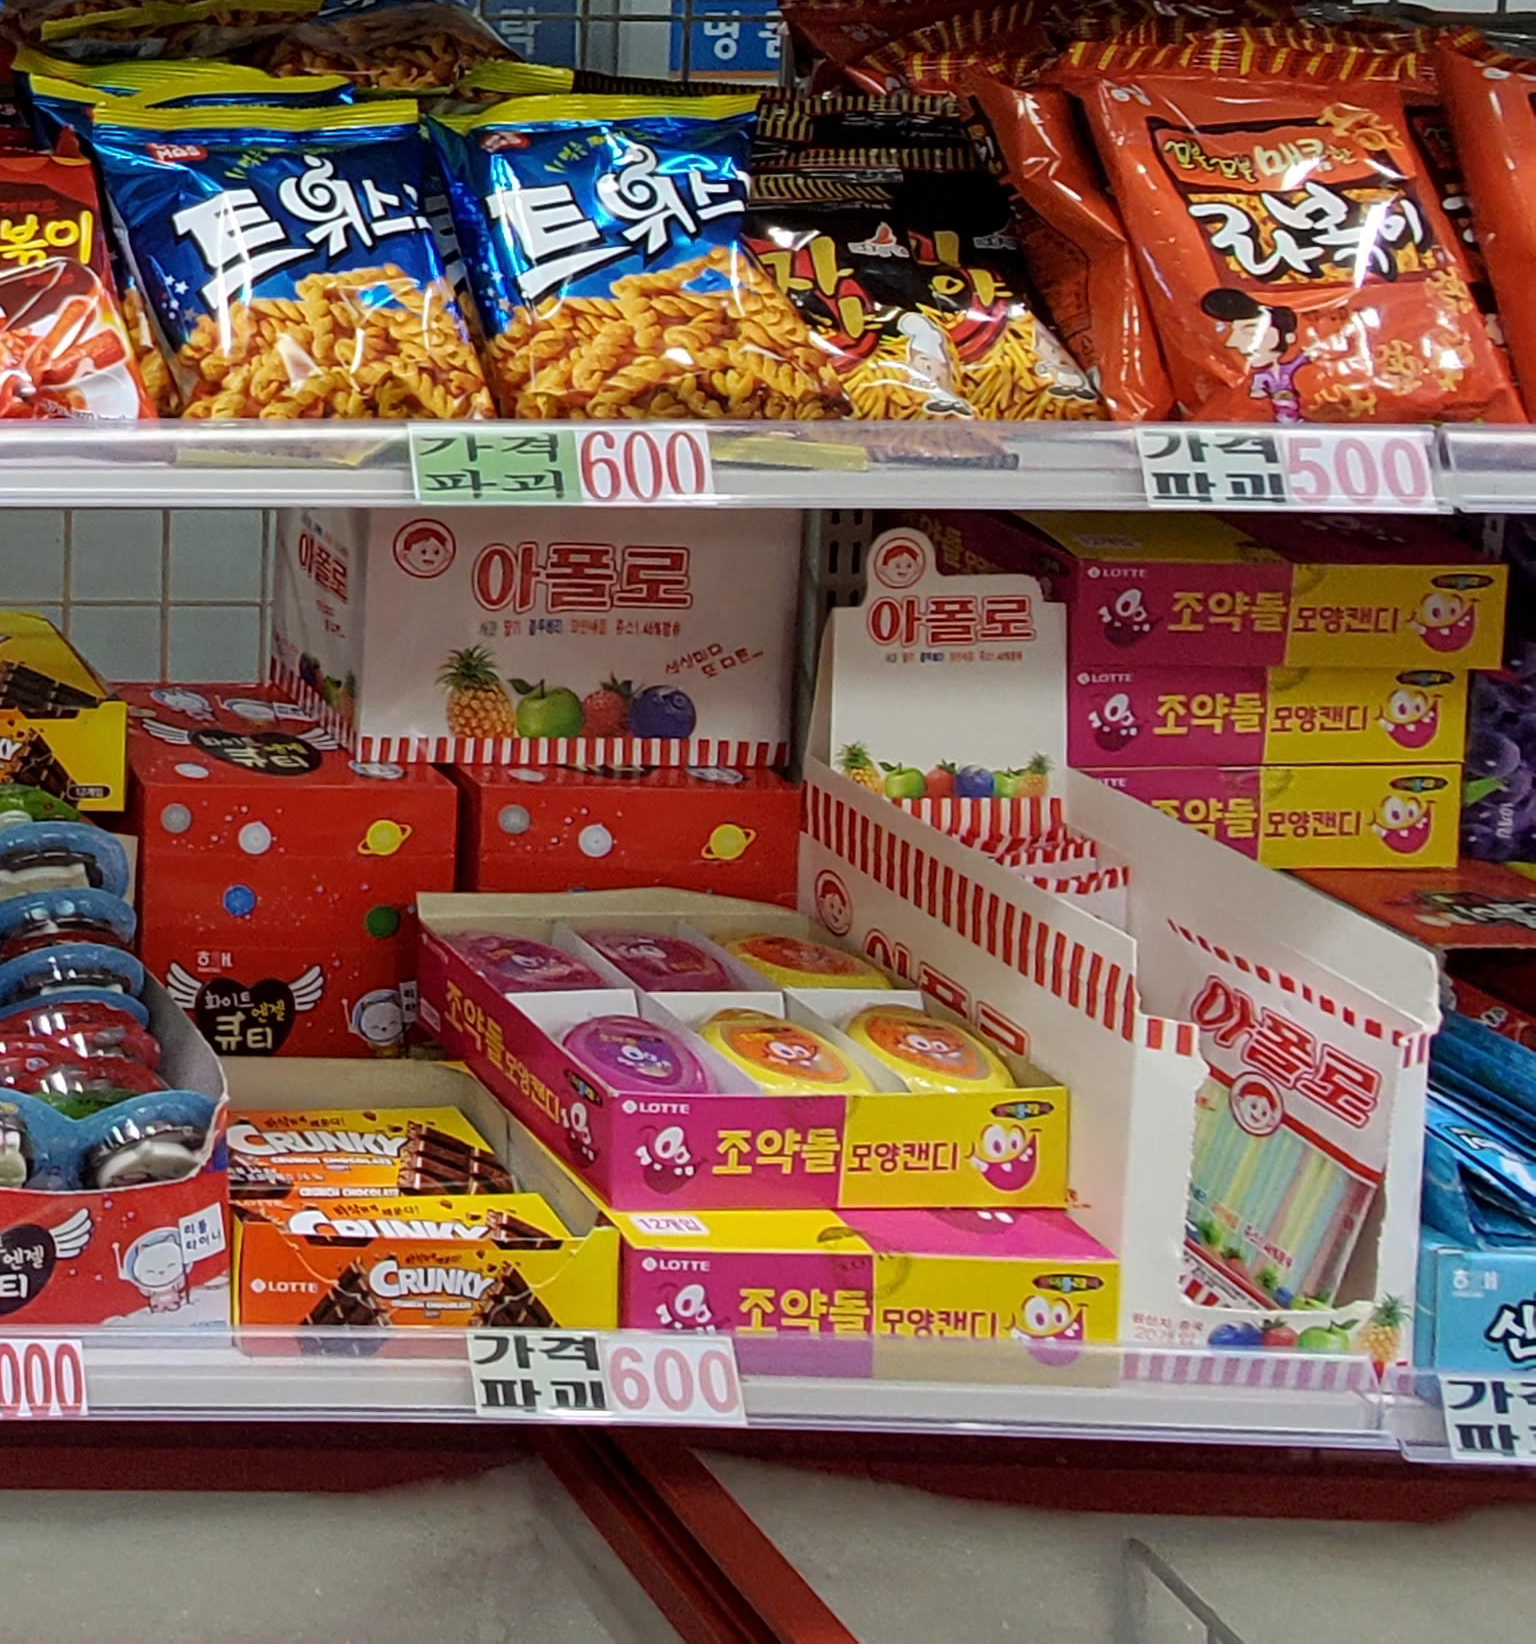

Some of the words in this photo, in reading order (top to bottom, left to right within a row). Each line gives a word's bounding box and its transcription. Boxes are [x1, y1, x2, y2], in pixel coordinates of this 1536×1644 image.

[580, 431, 706, 503] 600
[1287, 439, 1431, 507] 500
[472, 540, 693, 615] 아폴로
[1103, 566, 1148, 579] LOTTE
[867, 594, 1037, 648] 아폴로
[1167, 590, 1290, 635] 조약돌
[1293, 607, 1398, 635] 모양캔디
[1091, 672, 1133, 685] LOTTE
[1153, 693, 1265, 736] 조약돌
[1270, 705, 1368, 734] 모양캔디
[1264, 809, 1362, 839] 모양캔디
[204, 990, 252, 1011] 화이트
[251, 1000, 287, 1022] 엔젤
[215, 1012, 273, 1051] 큐티
[1188, 972, 1384, 1130] 아폴로
[639, 1101, 690, 1115] LOTTE
[227, 1124, 409, 1156] CRUNKY
[712, 1127, 842, 1176] 조약돌
[847, 1141, 959, 1173] 모양캔디
[299, 1188, 340, 1197] CRUNCH
[342, 1188, 400, 1197] CHOCOLATE
[4, 1244, 46, 1268] 엔젤
[660, 1258, 711, 1272] LOTTE
[268, 1281, 318, 1293] LOTTE
[369, 1260, 495, 1300] CRUNKY
[738, 1288, 871, 1335] 조약돌
[609, 1347, 740, 1413] 600
